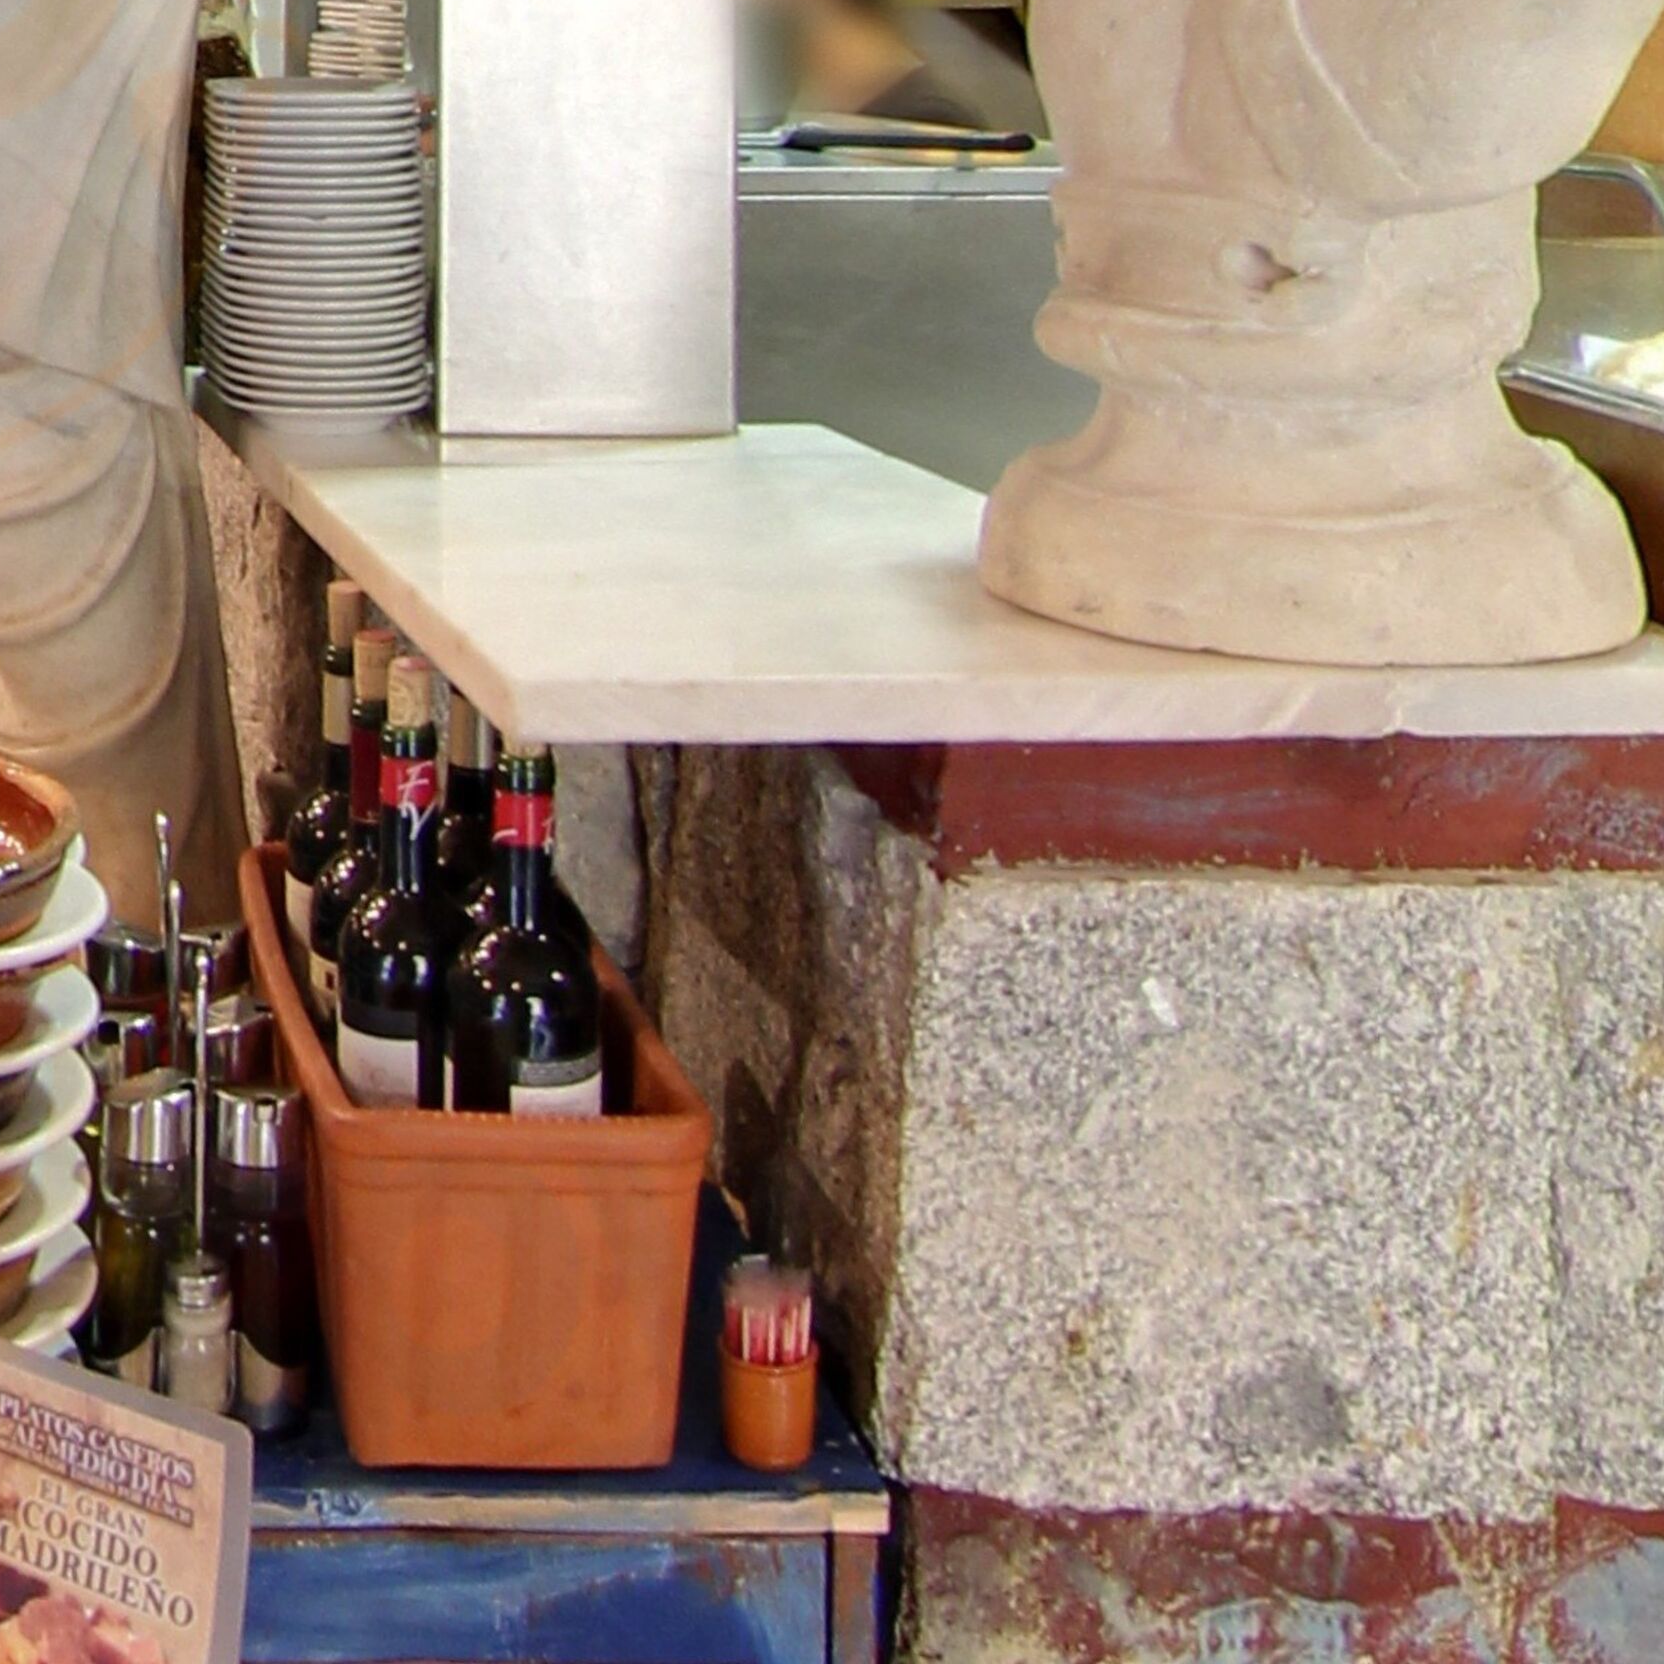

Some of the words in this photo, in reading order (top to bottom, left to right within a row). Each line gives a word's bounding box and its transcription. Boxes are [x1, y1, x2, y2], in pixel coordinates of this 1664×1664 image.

[87, 1426, 195, 1488] CASEROS
[23, 1499, 158, 1577] COCIDO
[40, 1479, 67, 1506] EL
[75, 1493, 146, 1538] GRAN
